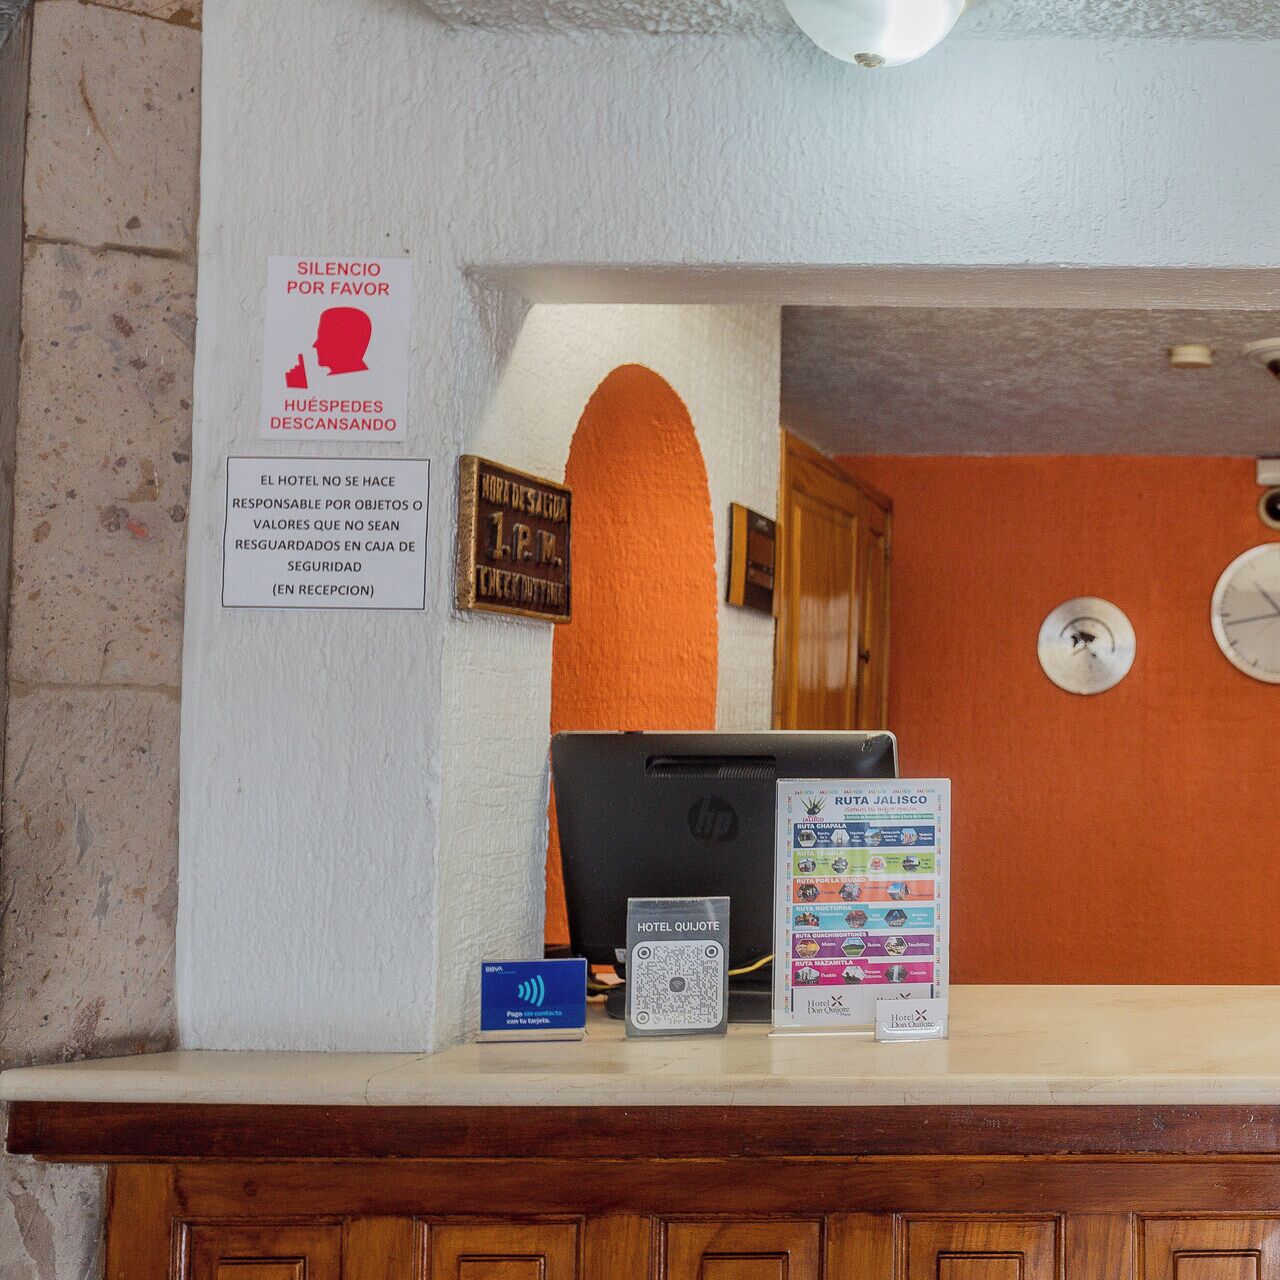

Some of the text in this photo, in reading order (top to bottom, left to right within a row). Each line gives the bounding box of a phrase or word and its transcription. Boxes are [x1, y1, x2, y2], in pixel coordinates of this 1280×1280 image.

[297, 261, 381, 276] SILENCIO
[287, 280, 390, 296] POR FAVOR
[284, 396, 383, 413] HUÉSPEDES
[270, 417, 397, 431] DESCANSANDO
[260, 475, 395, 487] EL HOTEL NO SE HACE
[482, 473, 511, 506] HORA
[232, 498, 423, 511] RESPONSABLE POR OBJETOS O
[253, 519, 400, 532] VALORES QUE NO SEAN
[235, 539, 415, 552] RESGUARDADOS EN CAJA DE
[287, 561, 362, 573] SEGURIDAD
[272, 583, 375, 598] (EN RECEPCION)
[835, 795, 927, 805] RUTA JALISCO
[637, 921, 720, 932] HOTEL QUIJOTE
[807, 998, 830, 1008] Hotel
[506, 1010, 523, 1019] Pago
[807, 1006, 850, 1017] Don Quijote
[891, 1013, 914, 1022] Hotel
[891, 1020, 907, 1029] Don
